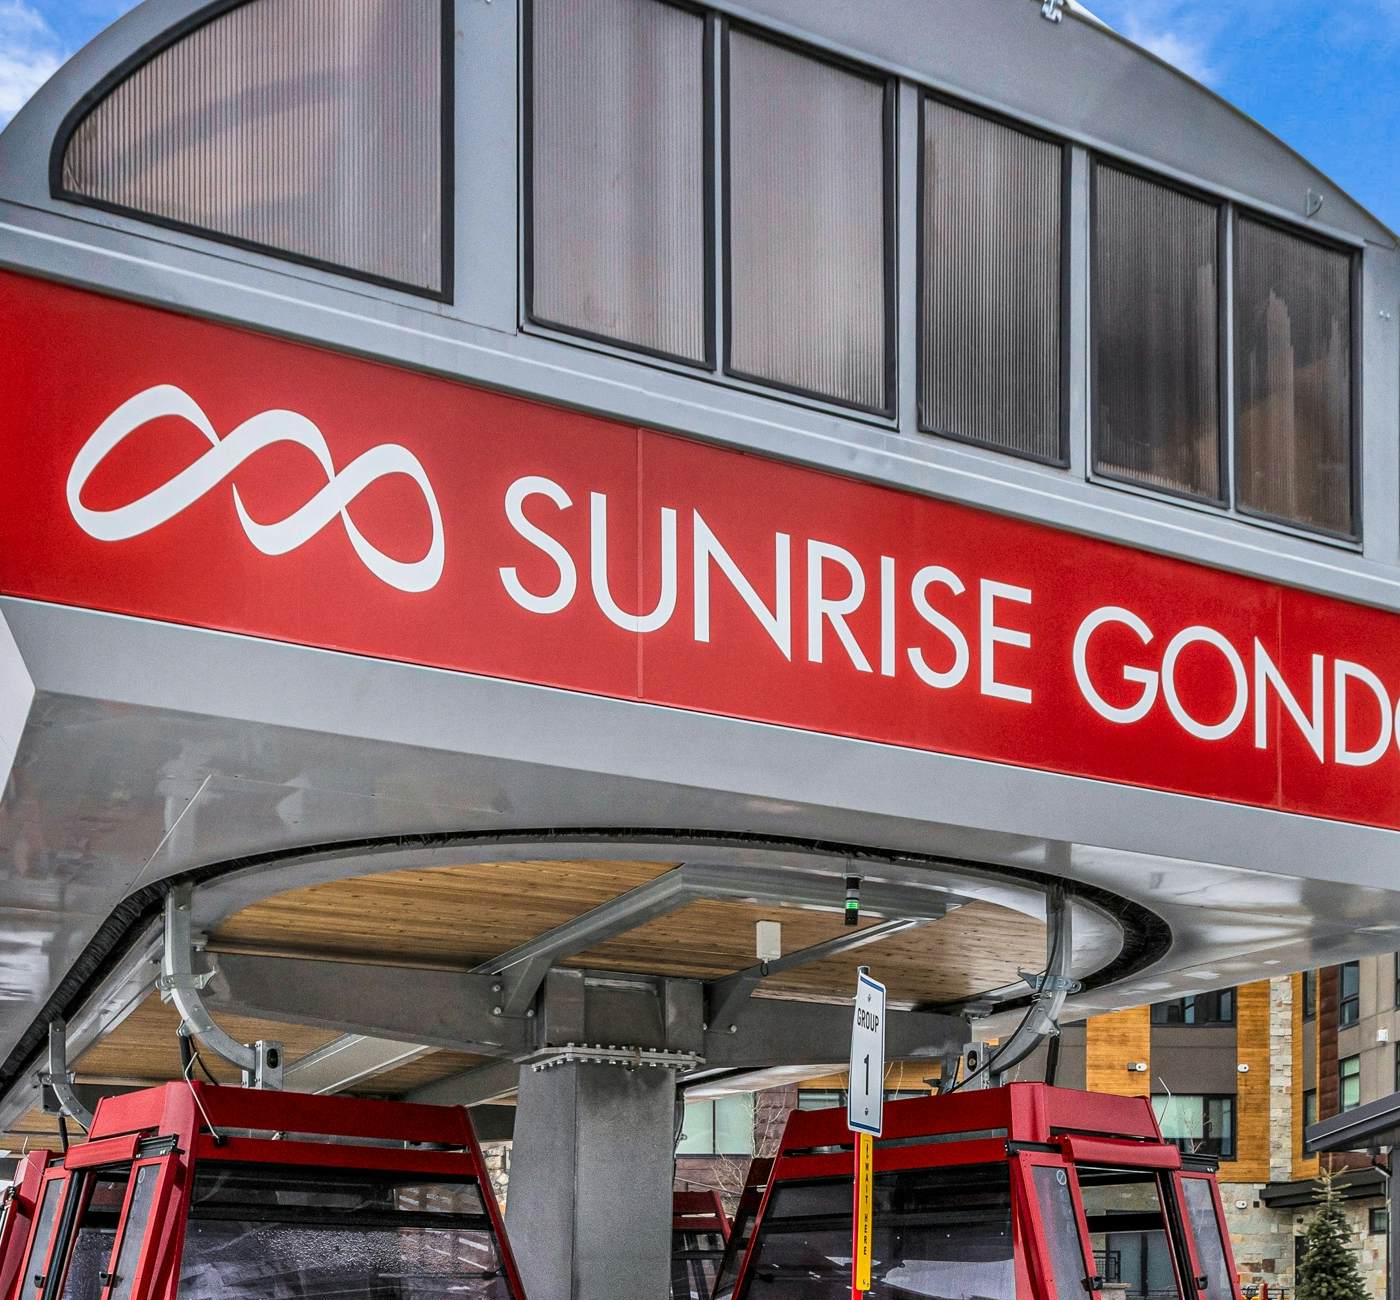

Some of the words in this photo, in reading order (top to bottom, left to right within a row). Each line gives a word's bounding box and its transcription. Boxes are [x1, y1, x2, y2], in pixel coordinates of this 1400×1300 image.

[499, 475, 1033, 703] SUNRISE
[1073, 605, 1400, 767] GOND
[857, 1007, 880, 1033] GROUP
[863, 1053, 870, 1096] 1
